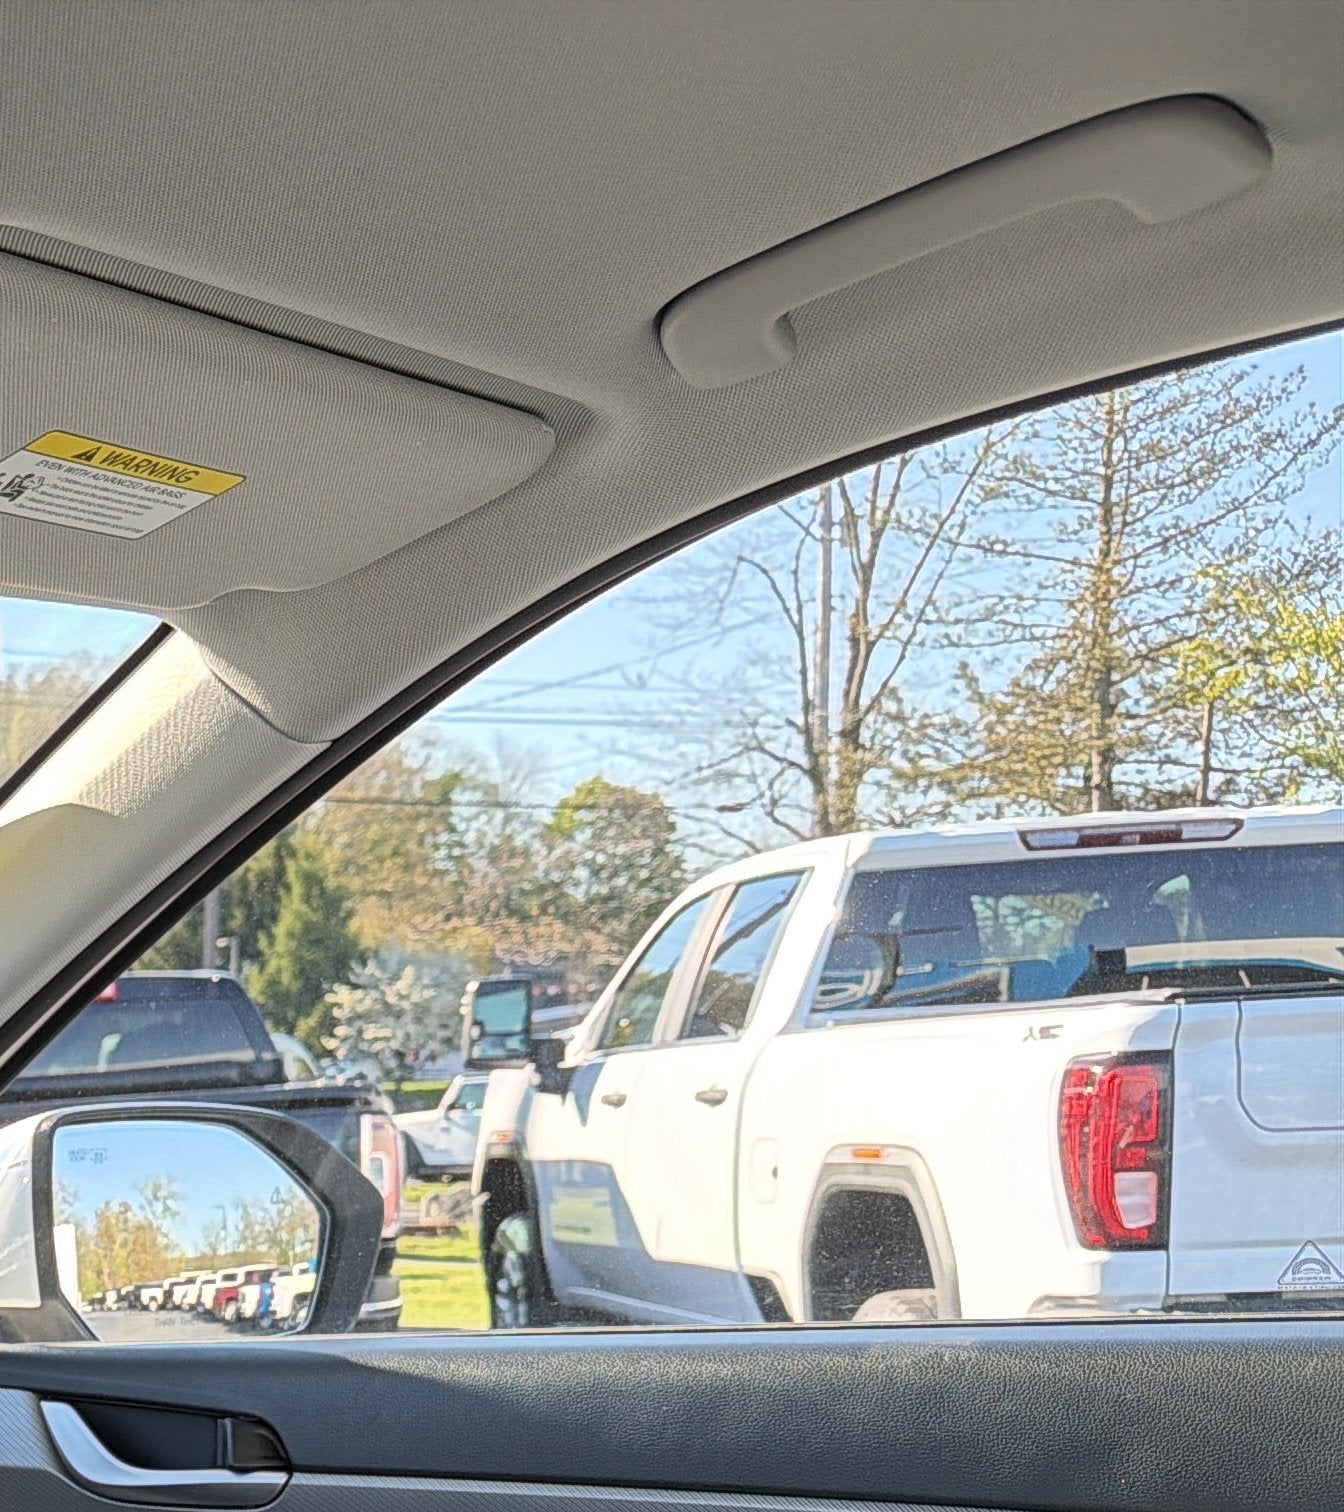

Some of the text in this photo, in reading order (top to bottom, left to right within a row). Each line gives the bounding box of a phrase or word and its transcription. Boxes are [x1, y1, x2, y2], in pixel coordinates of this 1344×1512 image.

[35, 459, 66, 471] EVEN
[63, 465, 91, 477] WITH
[91, 472, 144, 490] ADVANCED
[142, 484, 160, 493] AIR
[157, 487, 187, 500] BAGS
[98, 450, 200, 484] WARNING
